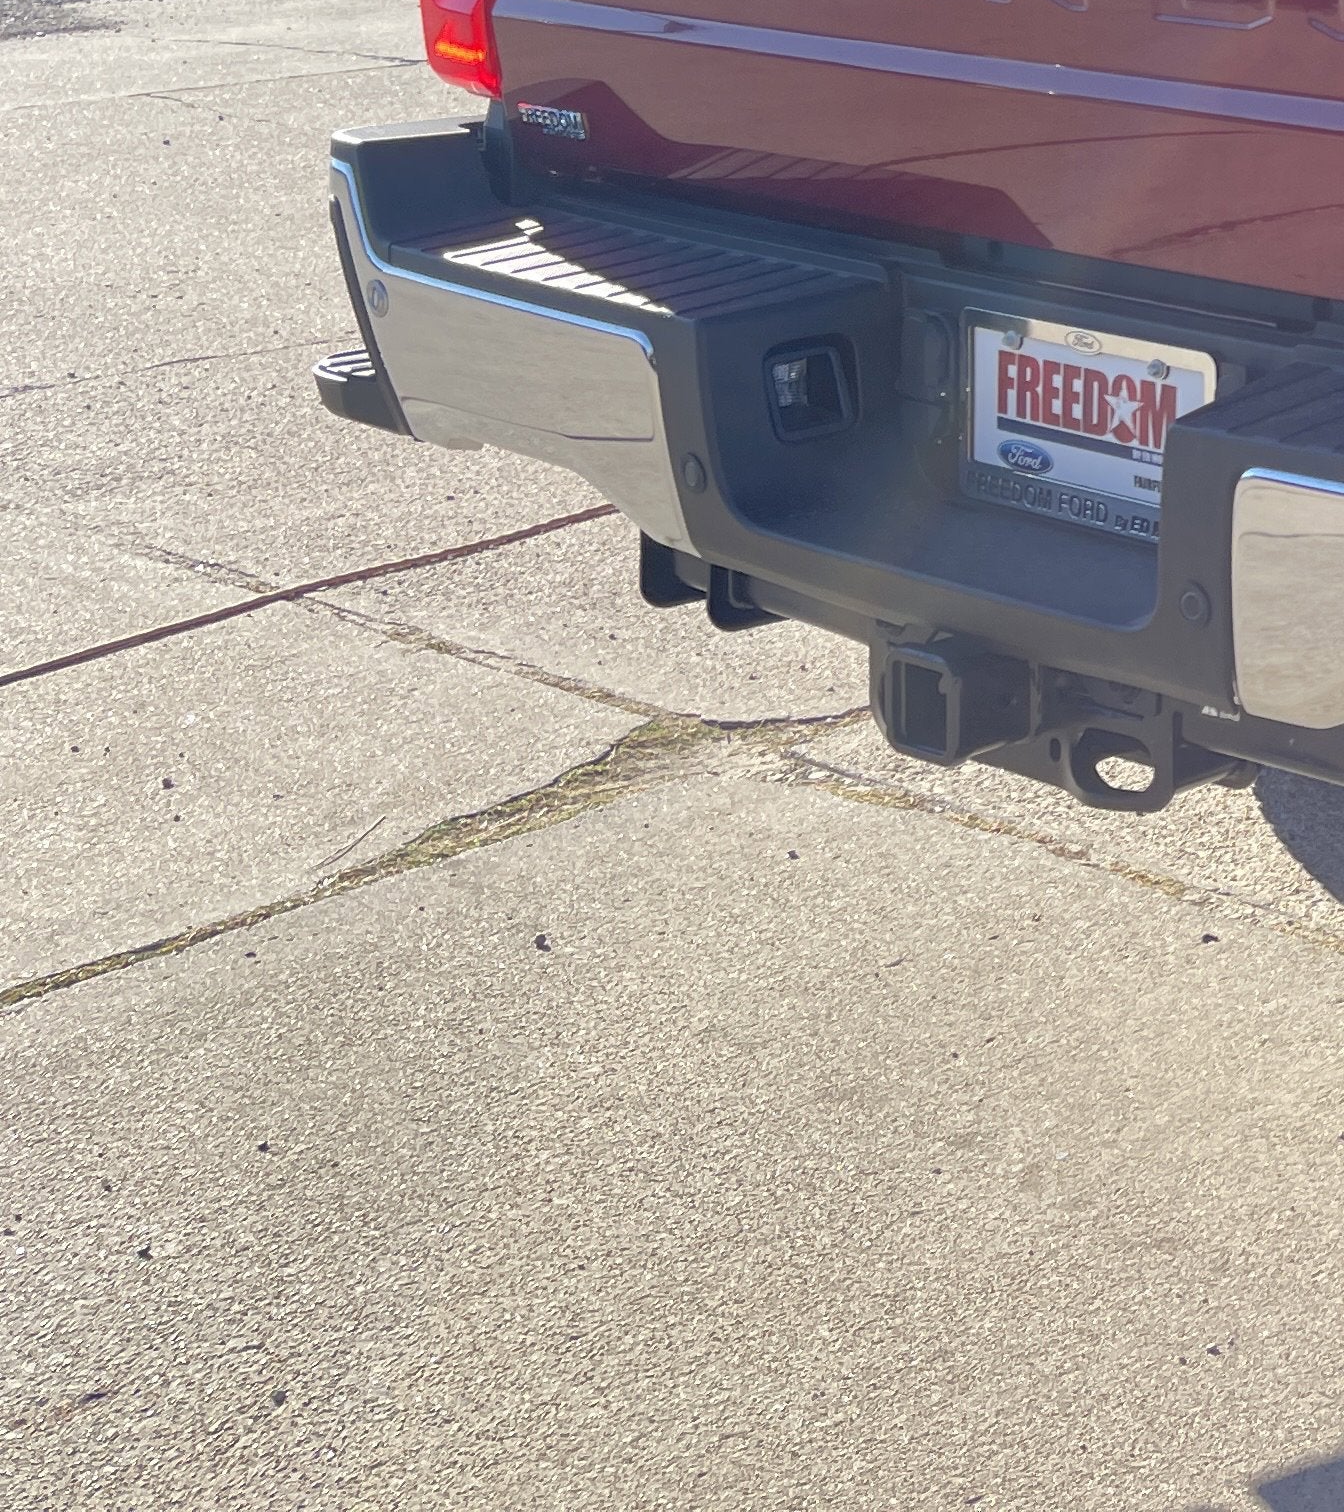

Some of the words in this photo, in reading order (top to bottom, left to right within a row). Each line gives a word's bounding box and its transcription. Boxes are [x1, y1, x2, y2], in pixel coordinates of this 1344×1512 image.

[997, 349, 1177, 450] FREEDOM
[1007, 445, 1043, 470] Ford
[966, 469, 1052, 511] FREEDOM
[1058, 491, 1109, 526] FORD
